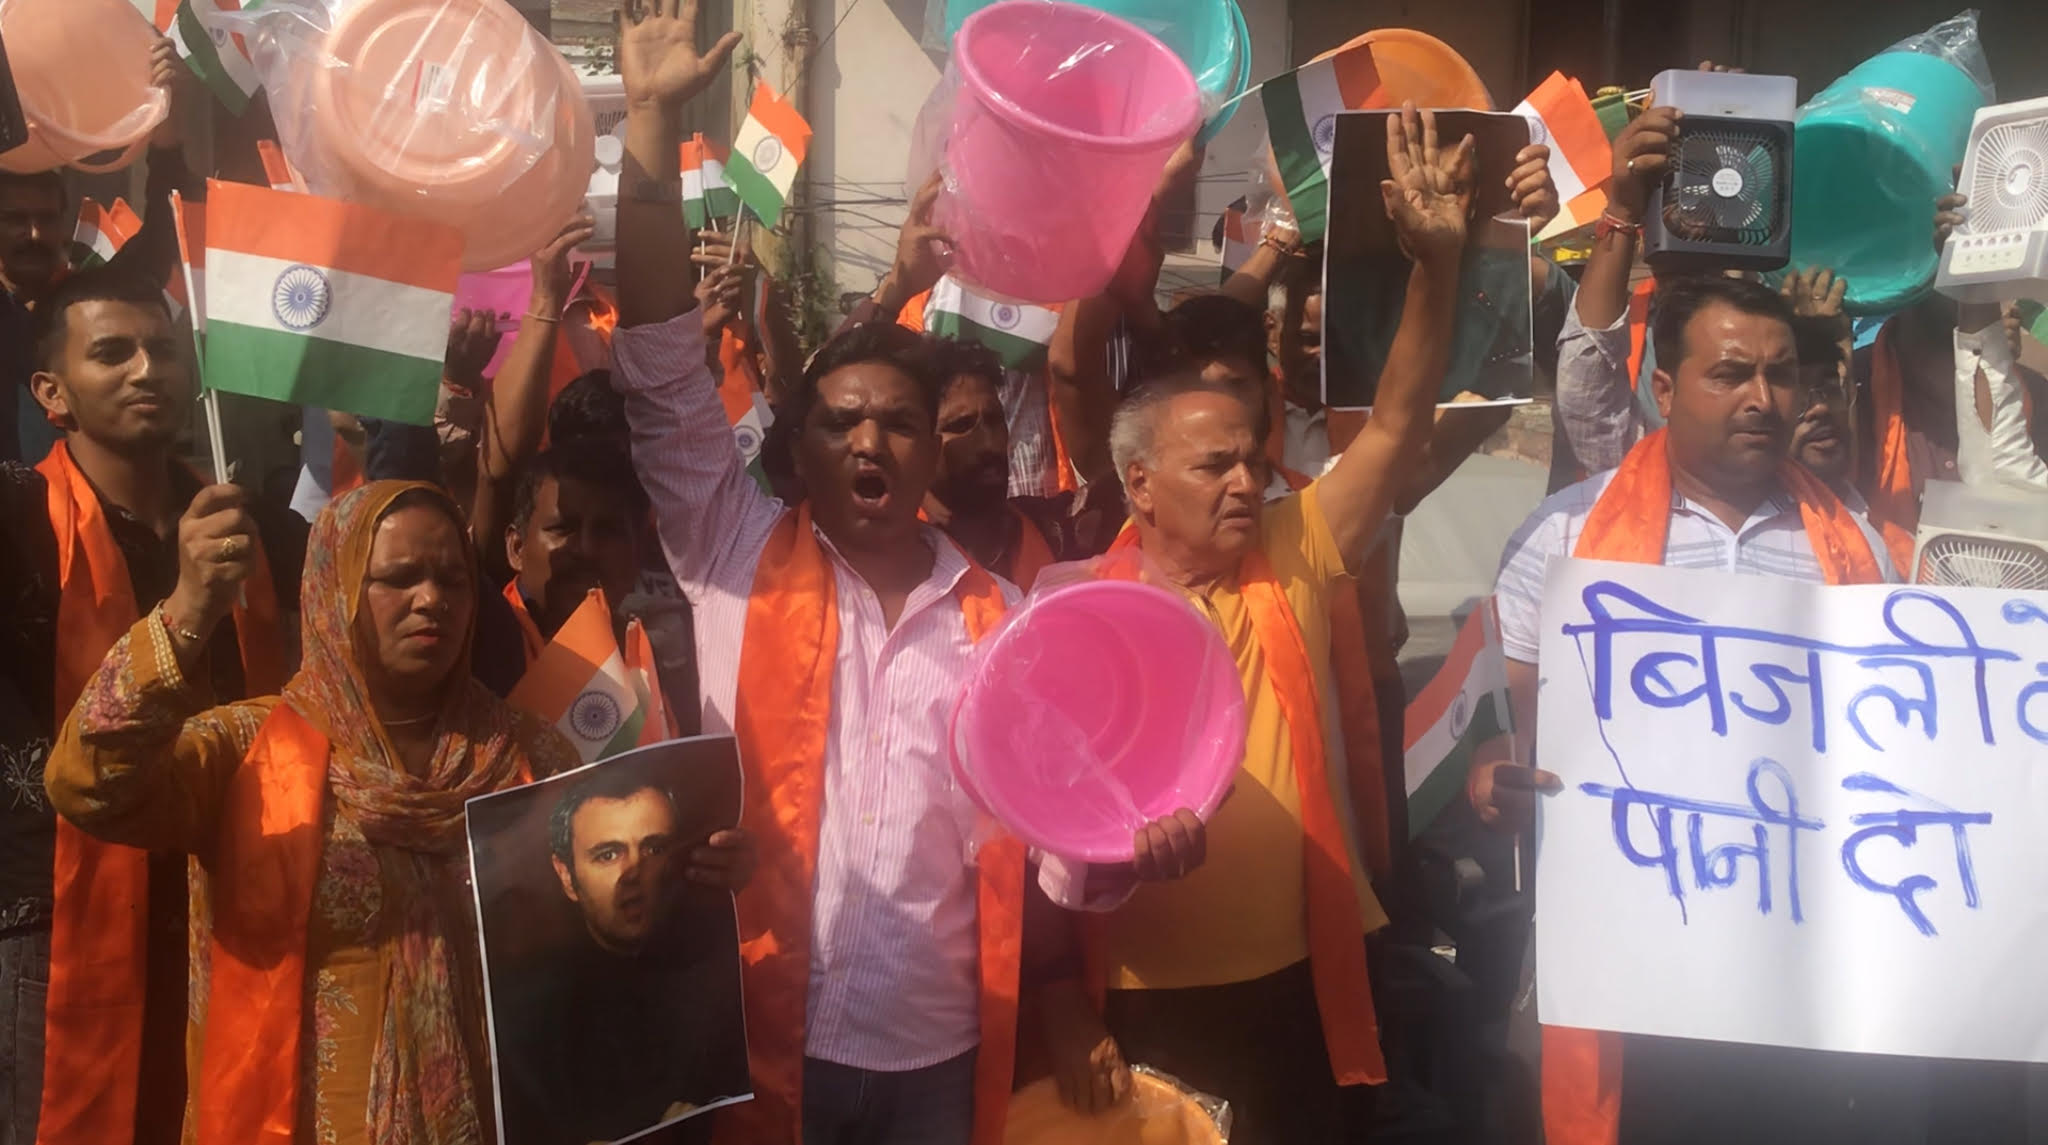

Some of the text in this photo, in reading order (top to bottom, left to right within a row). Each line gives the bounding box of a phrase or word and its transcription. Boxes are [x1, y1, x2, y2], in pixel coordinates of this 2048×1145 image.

[1562, 581, 2021, 754] बिजली
[1579, 757, 1993, 936] पानी दो
